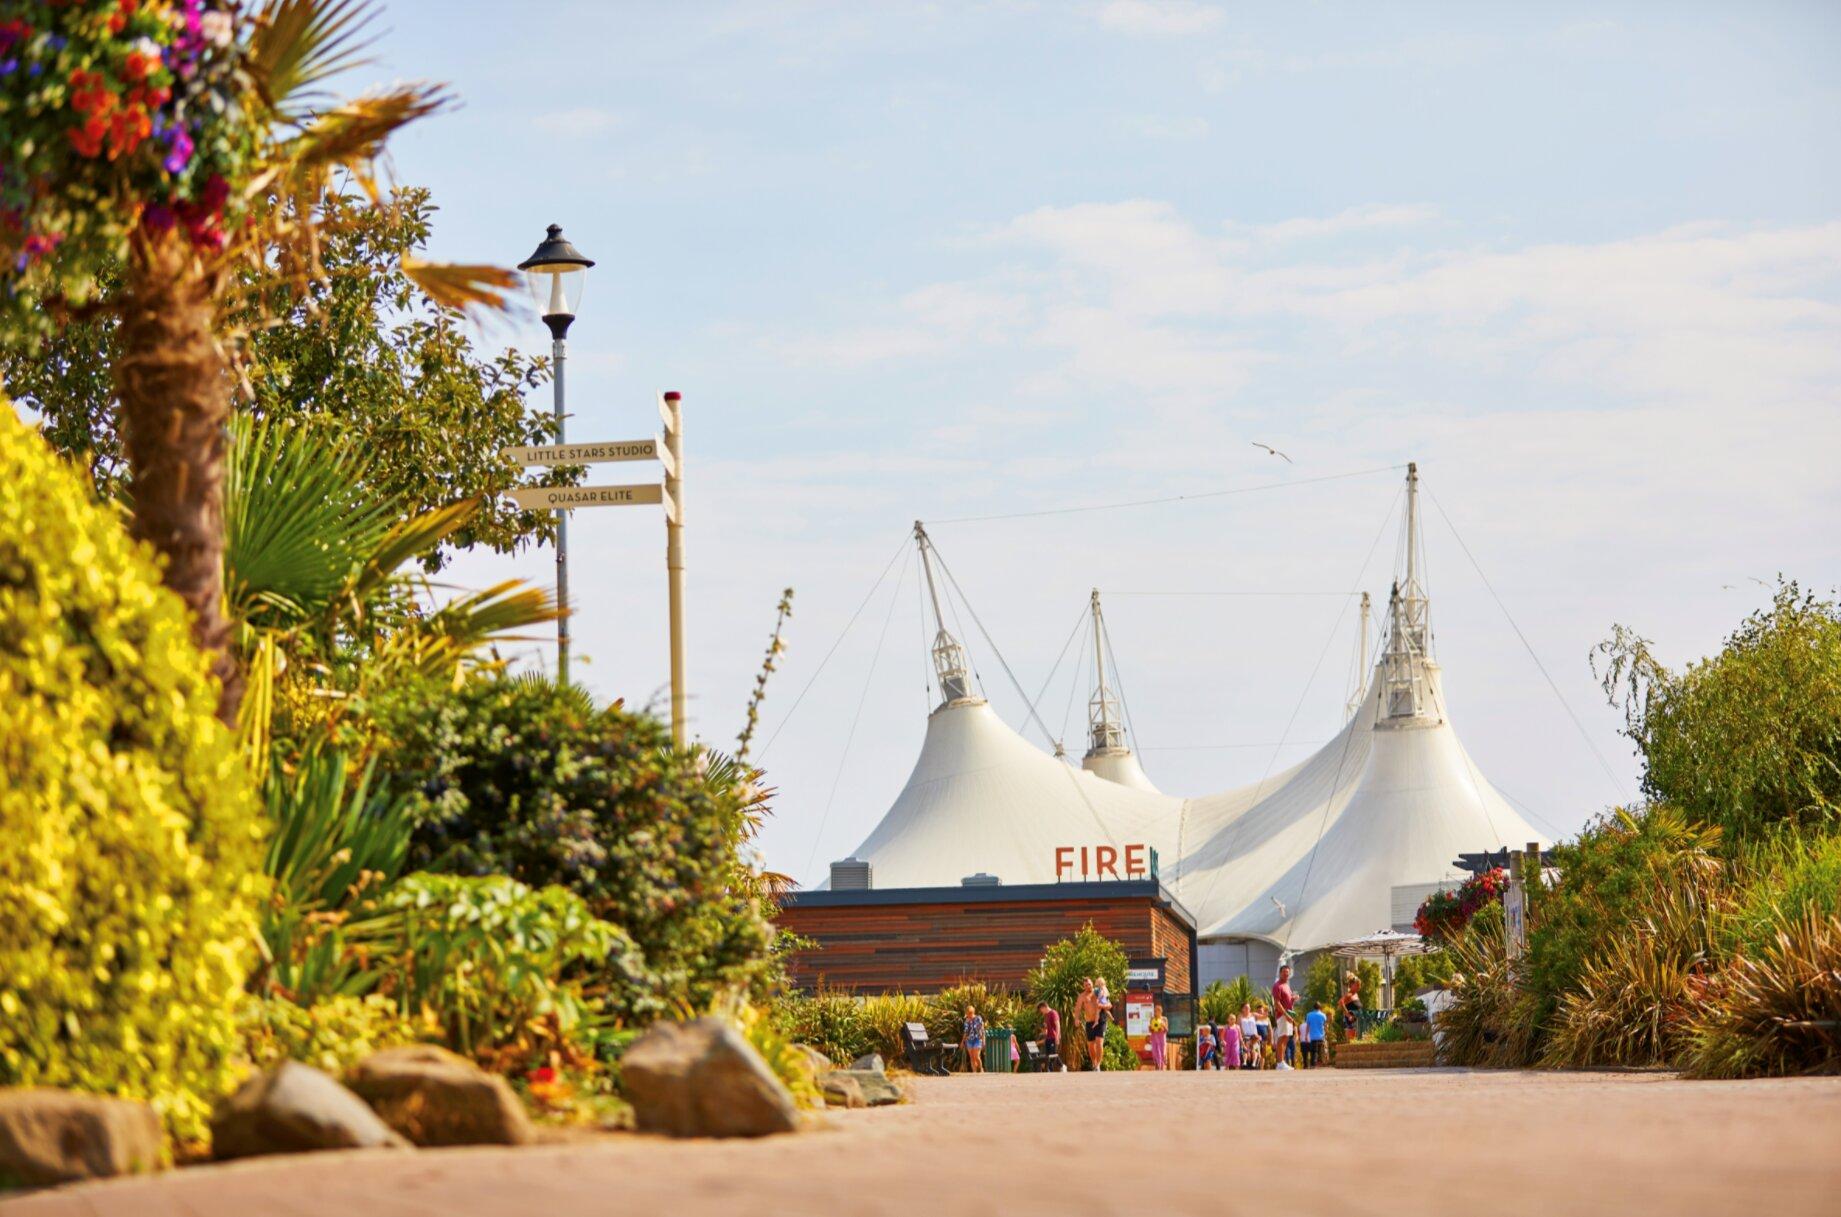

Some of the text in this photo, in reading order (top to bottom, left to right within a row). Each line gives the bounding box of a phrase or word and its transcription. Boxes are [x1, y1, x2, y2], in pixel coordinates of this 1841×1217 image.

[527, 445, 653, 461] LITTLE STARS STUDIO
[548, 489, 633, 504] QUASAR ELITE
[1055, 844, 1146, 876] FIRE
